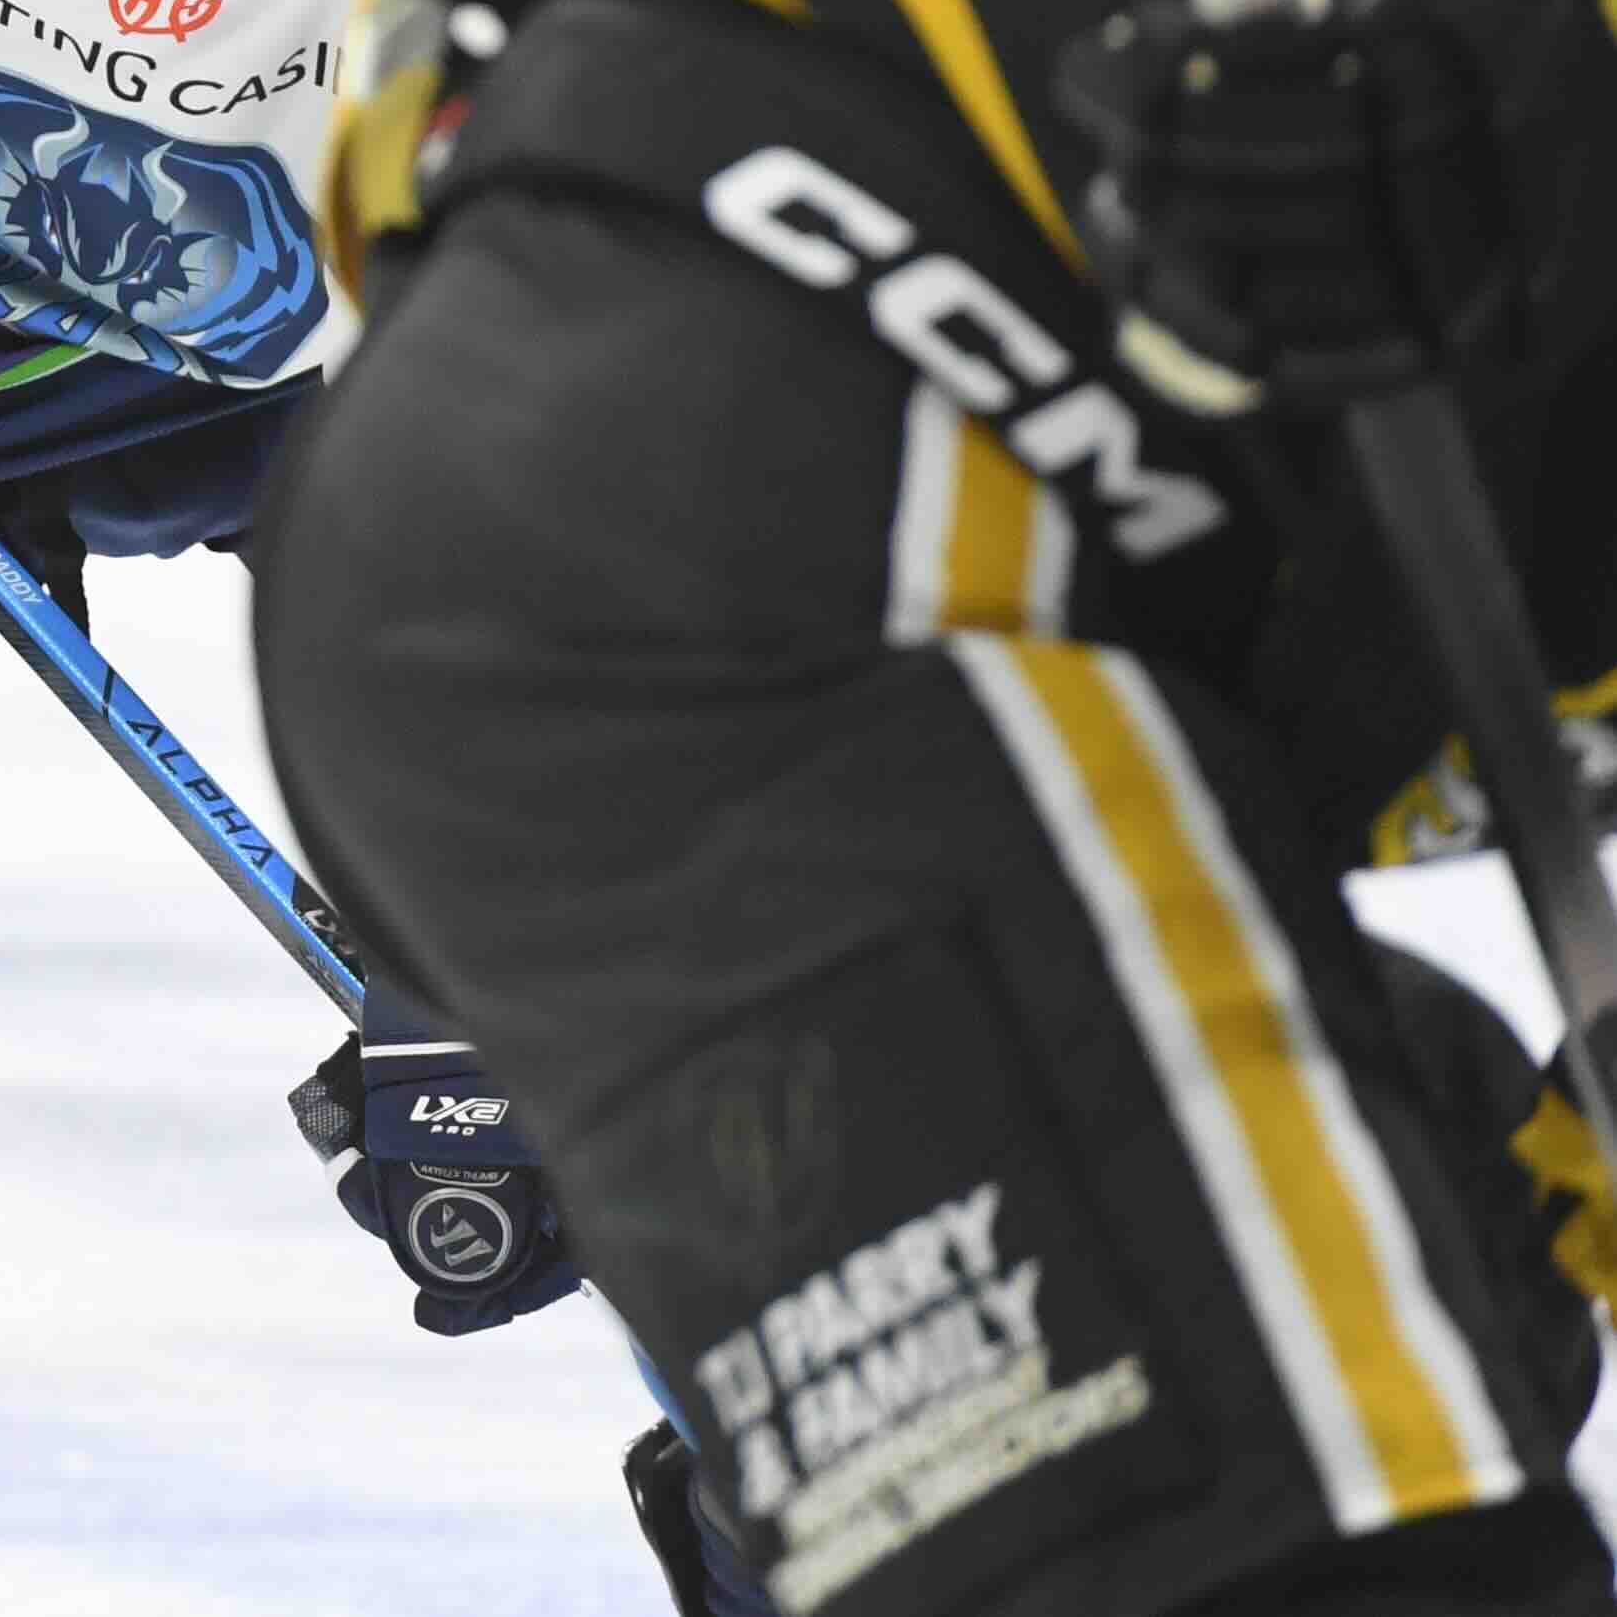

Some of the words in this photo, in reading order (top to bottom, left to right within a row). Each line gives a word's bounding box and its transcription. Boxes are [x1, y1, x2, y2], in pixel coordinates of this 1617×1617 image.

[702, 144, 1227, 566] CCM
[127, 717, 277, 872] ALPHA
[430, 1123, 476, 1137] PRO
